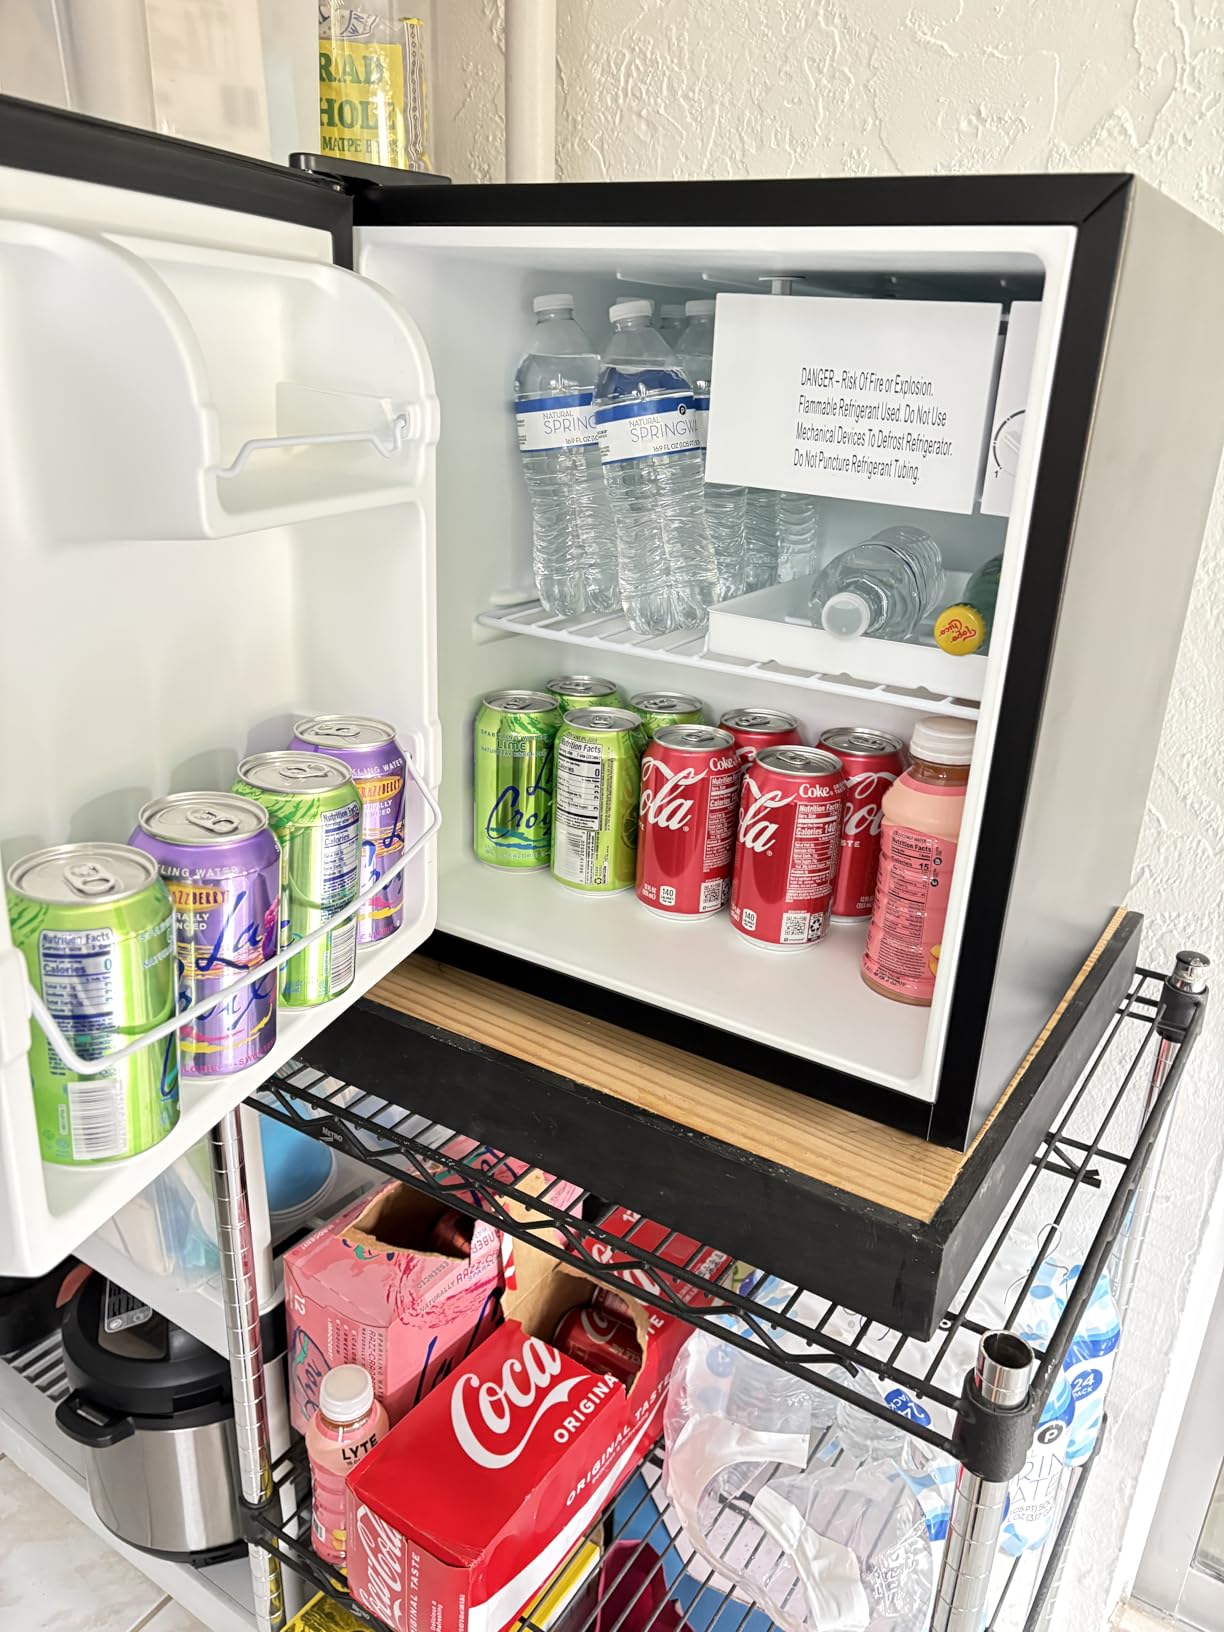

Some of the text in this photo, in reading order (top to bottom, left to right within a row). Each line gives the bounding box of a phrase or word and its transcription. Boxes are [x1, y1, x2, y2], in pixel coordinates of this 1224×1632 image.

[800, 367, 835, 388] DANGER
[841, 370, 857, 390] Risk
[858, 371, 869, 391] Of
[868, 372, 884, 393] Fire
[885, 381, 894, 393] or
[894, 374, 934, 399] Explosion.
[543, 410, 574, 420] NATURAL
[799, 394, 947, 427] Flammable Refrigerant Used. Do Not Use
[628, 416, 661, 428] NATURAL
[796, 421, 953, 459] Mechanical Devices To Defrost Refrigerator.
[793, 448, 920, 485] Do Not Puncture Refrigerant Tubing.
[994, 470, 999, 479] 1
[497, 740, 527, 751] LIME
[583, 744, 601, 754] Facts
[709, 757, 734, 772] Coke
[595, 768, 600, 777] 0
[639, 760, 708, 830] ola
[799, 783, 830, 798] Coke
[796, 827, 823, 835] Calories
[841, 840, 861, 848] STE
[914, 842, 932, 853] Facts
[918, 862, 929, 871] 15
[171, 890, 226, 905] AZZBERRY
[662, 887, 674, 897] 140
[744, 910, 755, 922] 140
[85, 931, 111, 944] Facts
[43, 958, 113, 975] Calories 0
[294, 1294, 305, 1315] 12
[1072, 1373, 1095, 1394] 24
[553, 1371, 620, 1444] ORIGINA
[341, 1432, 379, 1461] LYTE
[566, 1424, 631, 1506] ORIGINAL
[410, 1551, 420, 1590] TASTE
